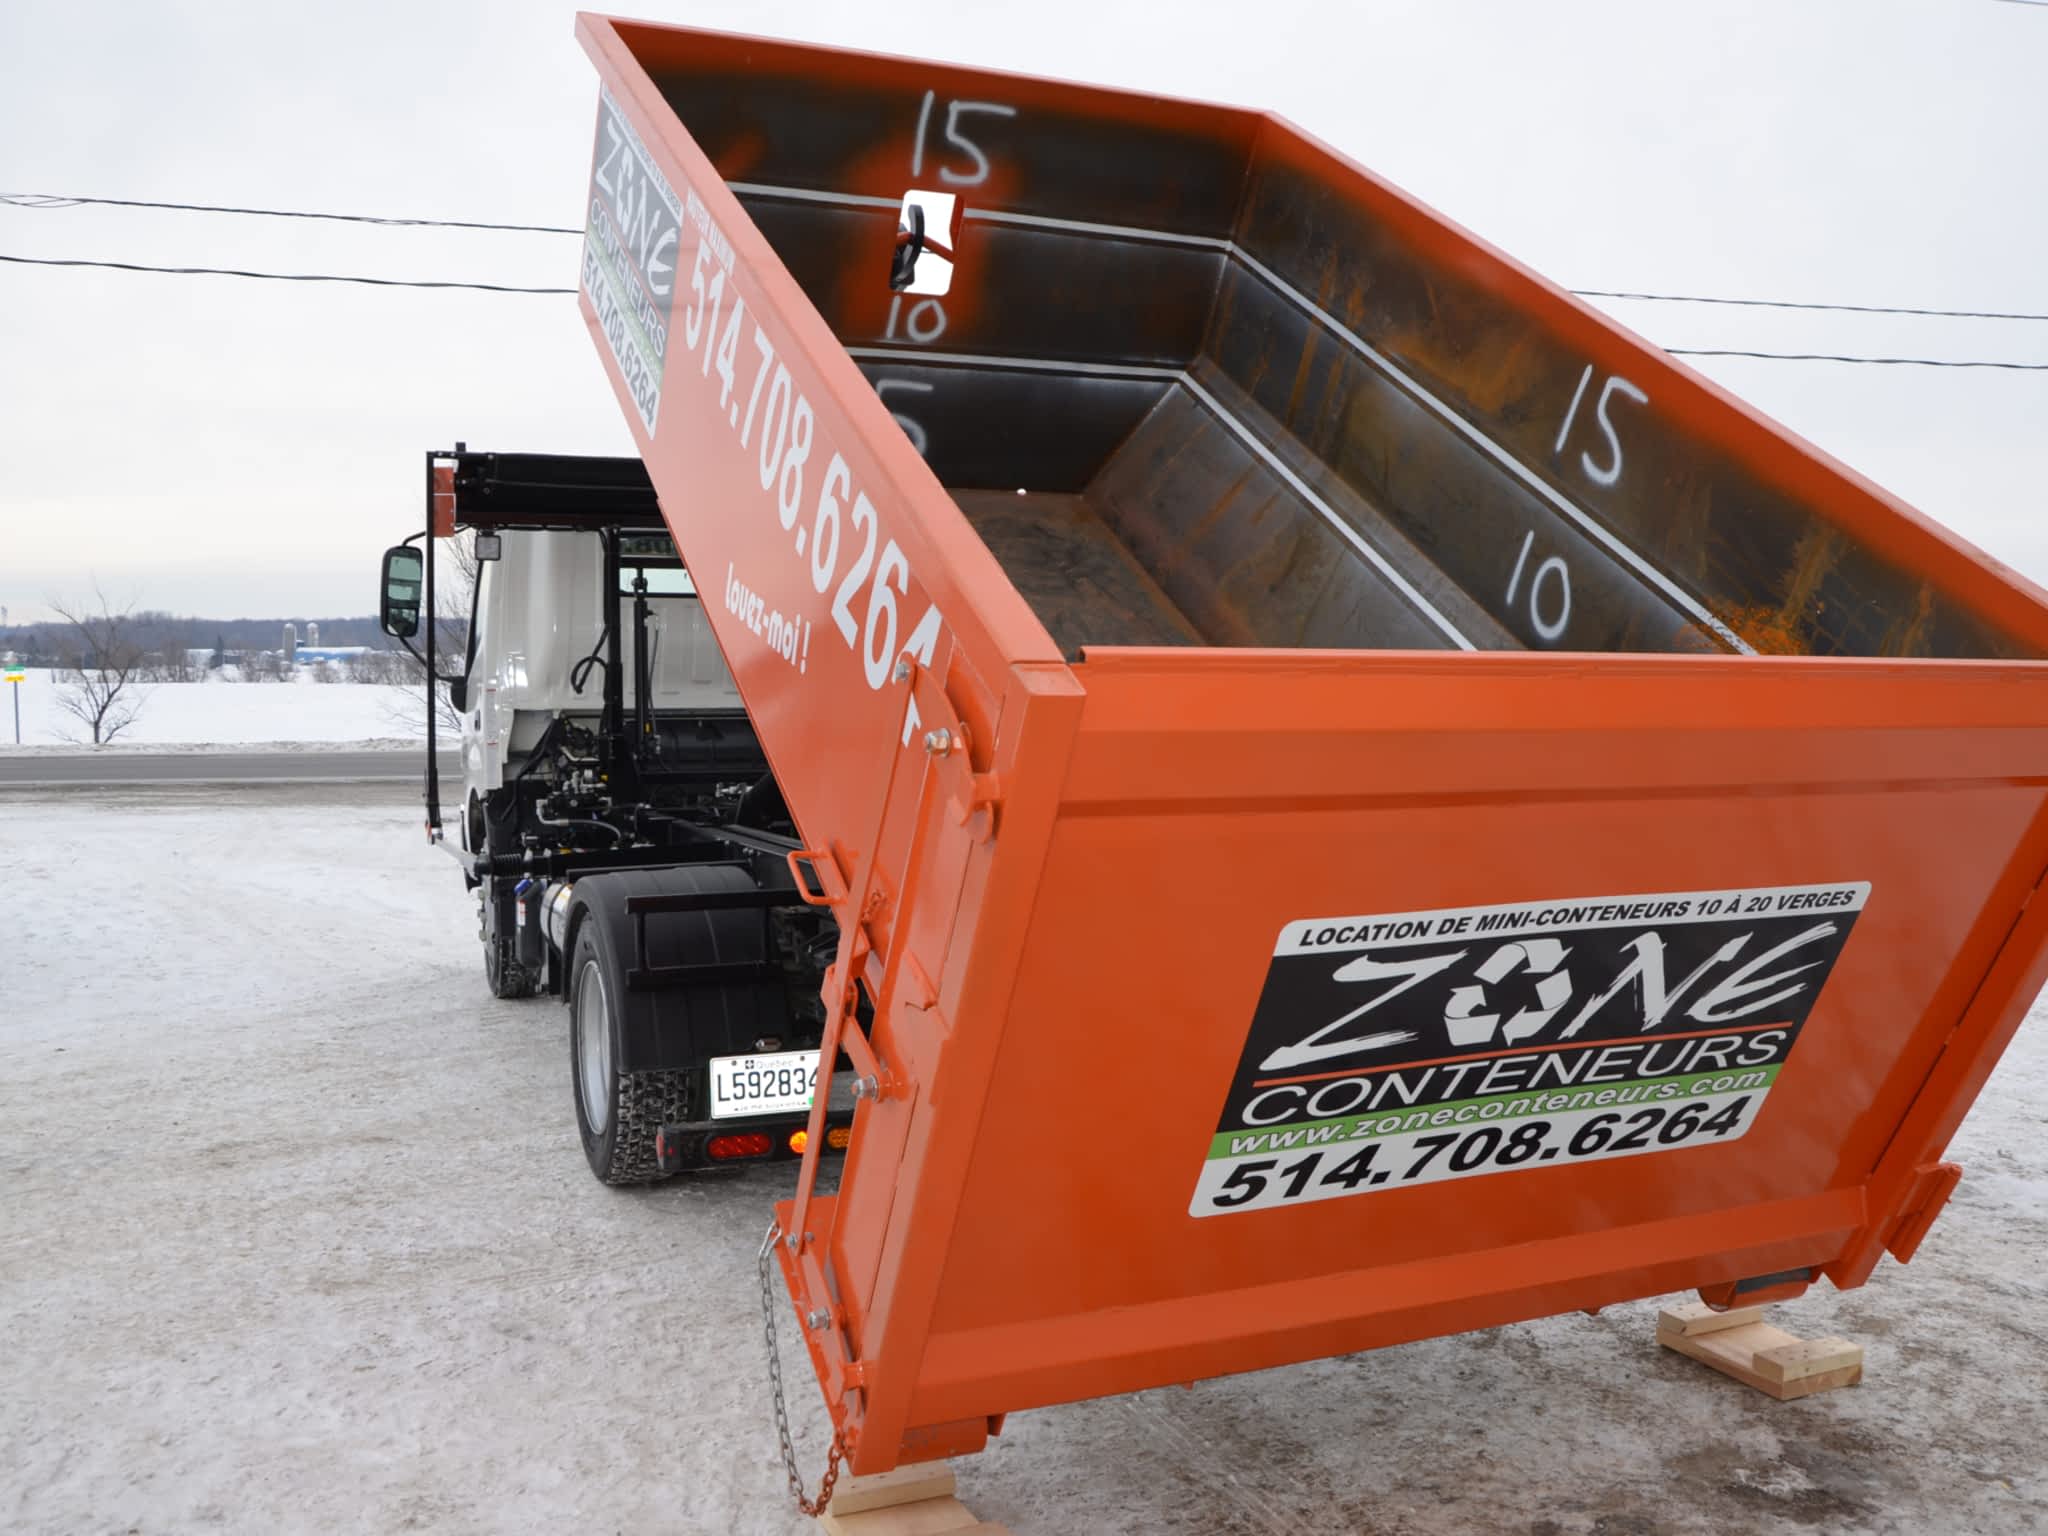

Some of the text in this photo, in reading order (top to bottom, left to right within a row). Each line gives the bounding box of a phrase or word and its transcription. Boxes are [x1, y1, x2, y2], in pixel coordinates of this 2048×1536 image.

[911, 89, 1017, 187] 15
[590, 197, 666, 359] CONTENEURS
[885, 294, 949, 344] 10
[583, 250, 657, 428] 514.708.6264
[874, 377, 937, 458] 5
[1555, 363, 1648, 487] 15
[685, 236, 943, 749] 514.708.6264
[1505, 530, 1572, 642] 10
[1298, 889, 1857, 947] LOCATION DE MINI-CONTENEURS 10 À 20 VERGES
[1258, 919, 1839, 1073] ZONE
[1229, 1066, 1769, 1156] www.zoneconteneurs.com
[1240, 1029, 1789, 1127] CONTENEURS
[1211, 1095, 1754, 1208] 514.708.6264
